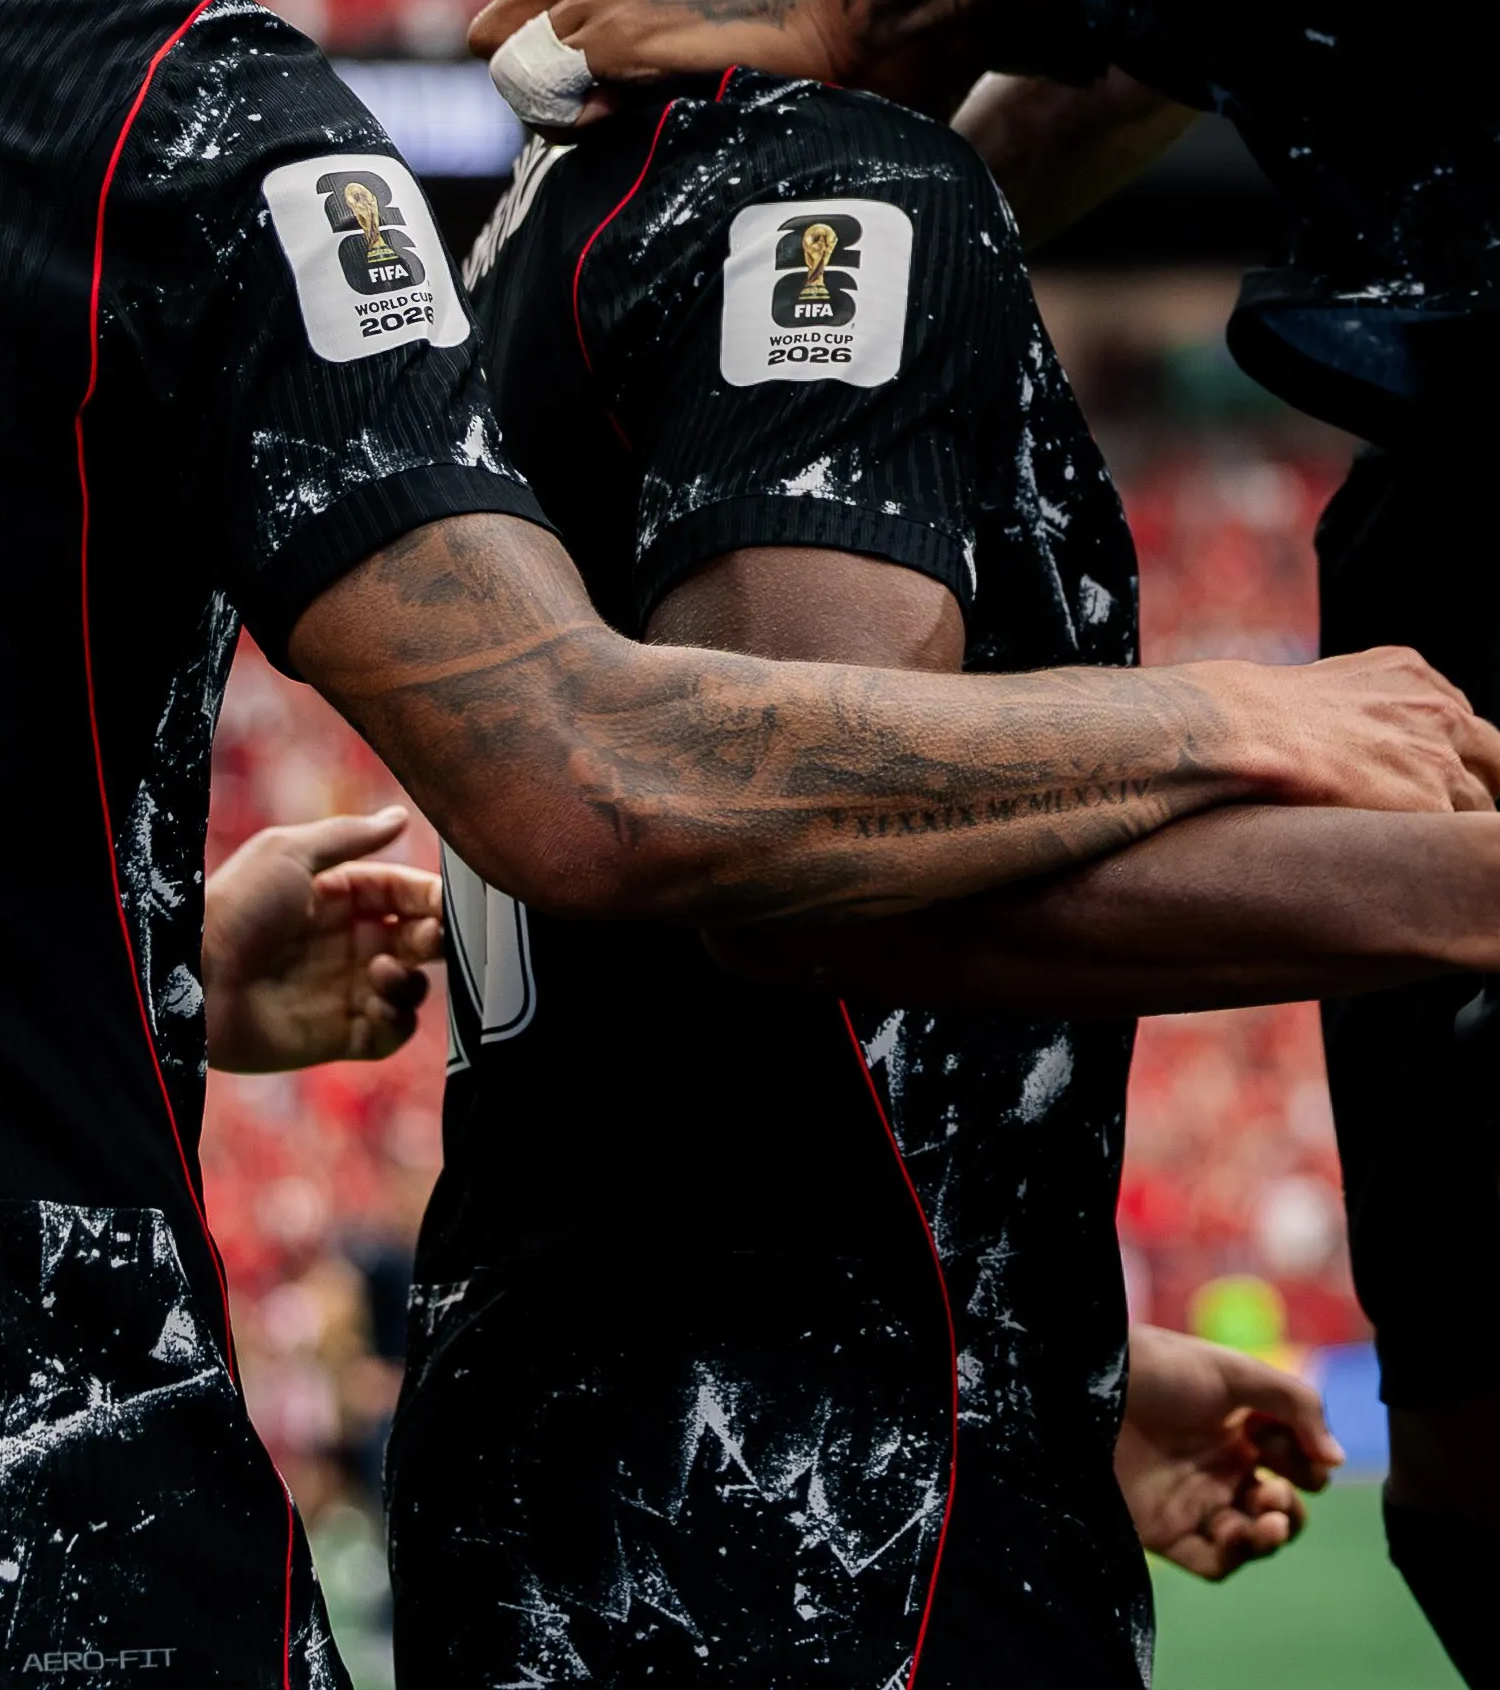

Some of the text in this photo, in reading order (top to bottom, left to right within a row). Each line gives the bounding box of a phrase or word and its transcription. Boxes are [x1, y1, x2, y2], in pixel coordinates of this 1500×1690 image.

[368, 264, 409, 283] FIFA
[355, 293, 434, 316] WORLD CUP
[794, 303, 834, 318] FIFA
[359, 306, 435, 338] 2026
[770, 332, 854, 346] WORLD CUP
[767, 346, 852, 366] 2026
[22, 1647, 177, 1673] AERO-FIT
